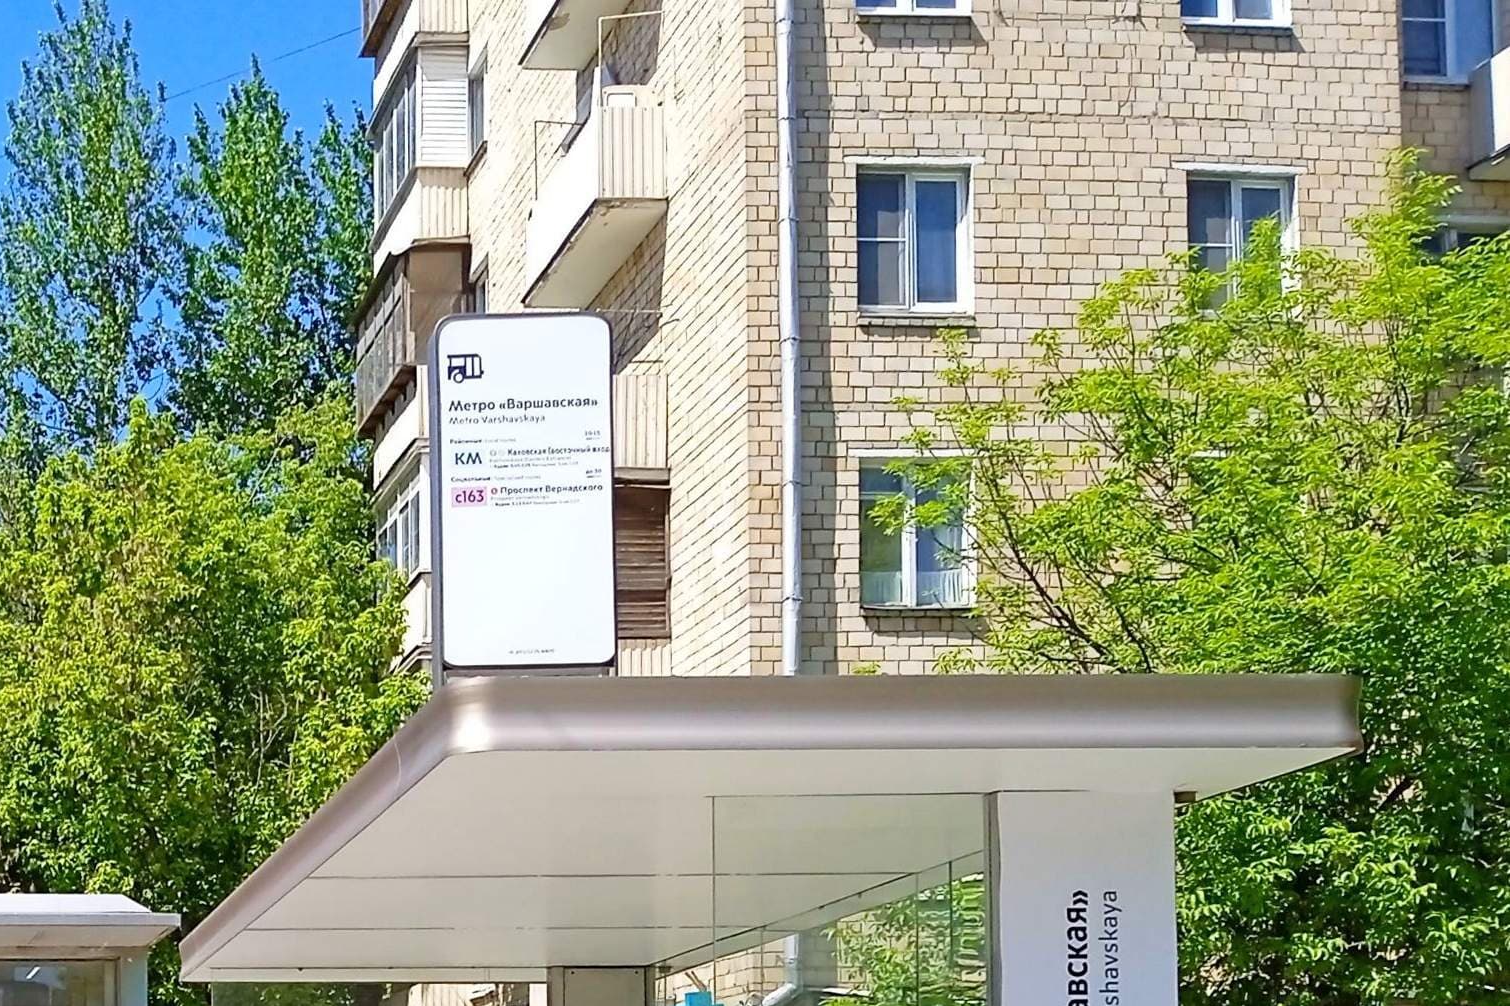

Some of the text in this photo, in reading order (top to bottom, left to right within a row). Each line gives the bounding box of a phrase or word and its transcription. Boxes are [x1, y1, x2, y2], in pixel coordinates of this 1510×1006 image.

[448, 398, 598, 412] Метро «Варшавская»
[449, 414, 546, 425] Metro Varshavskaya
